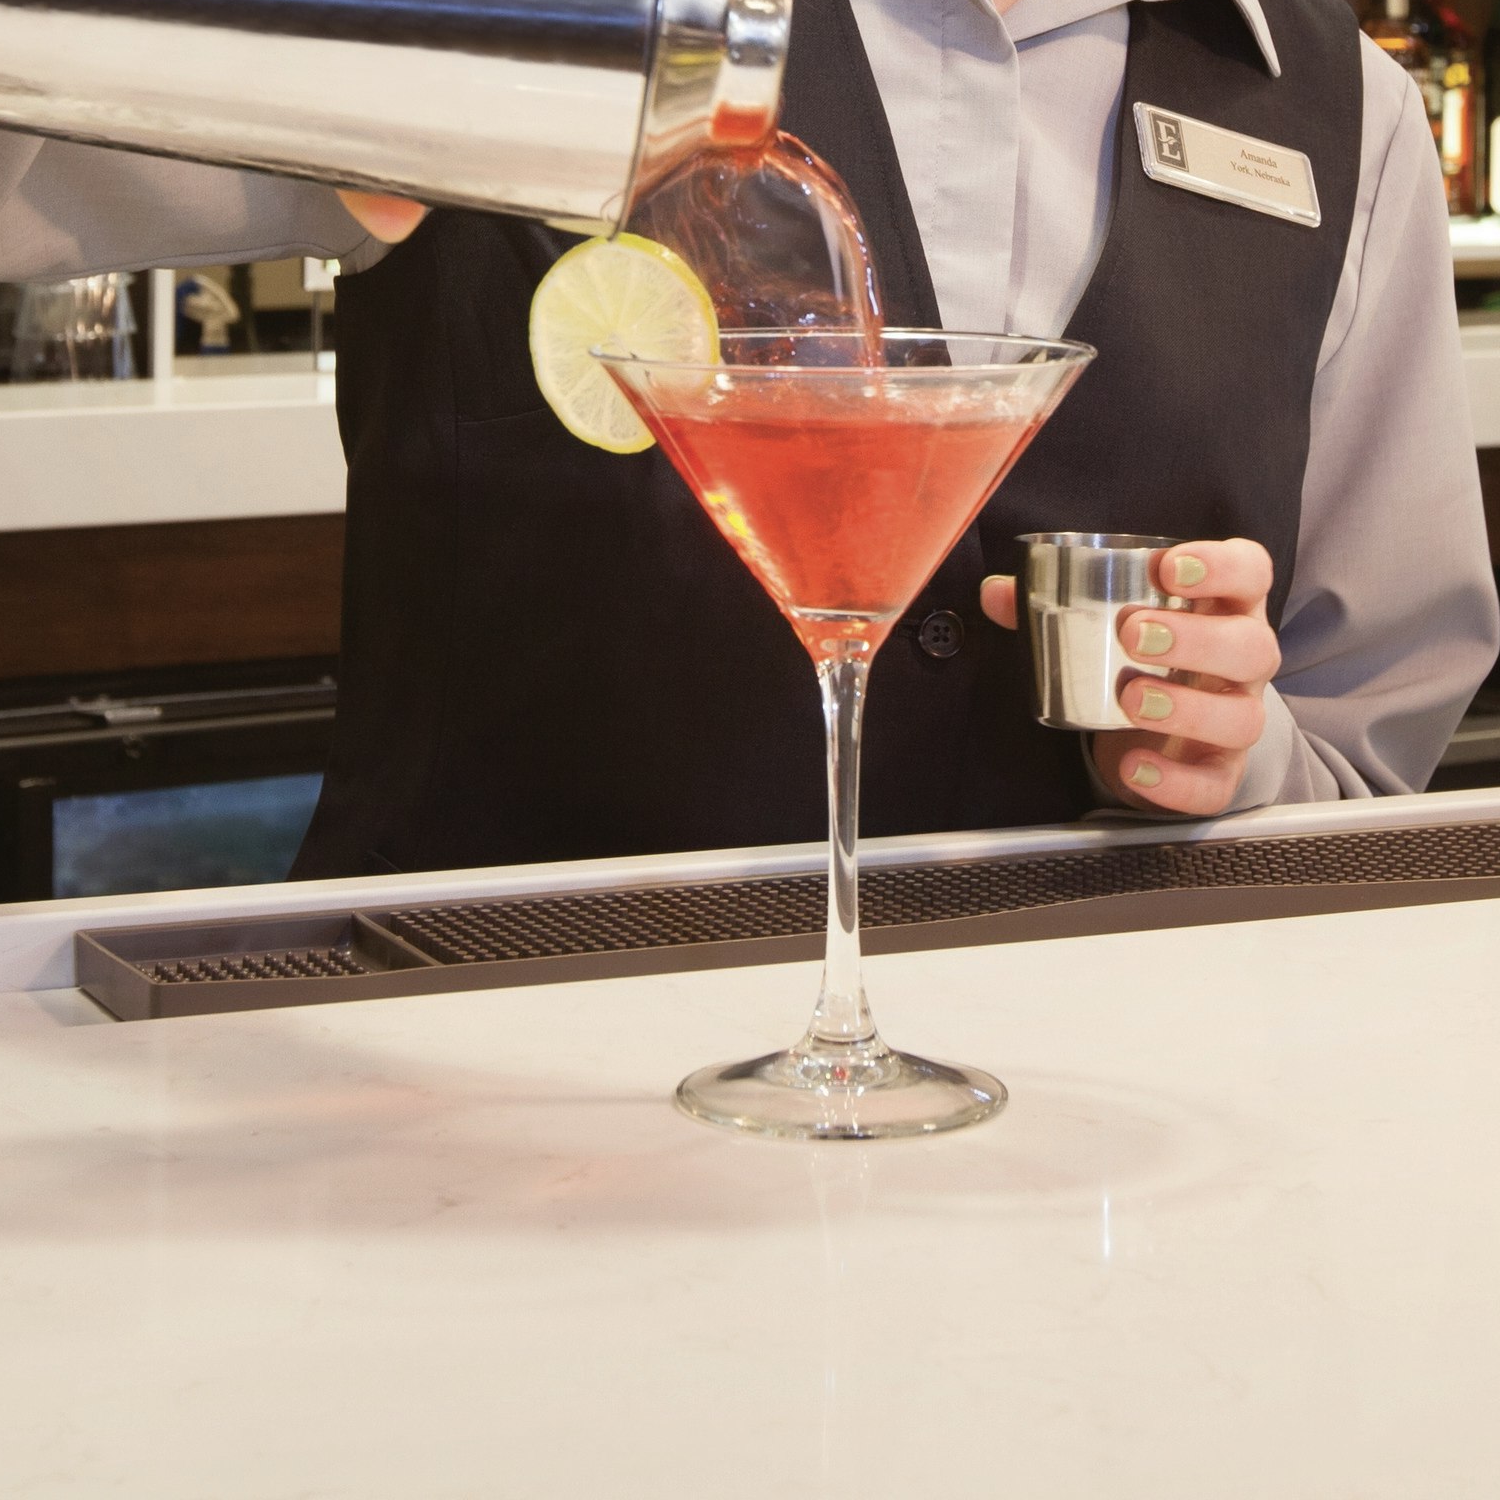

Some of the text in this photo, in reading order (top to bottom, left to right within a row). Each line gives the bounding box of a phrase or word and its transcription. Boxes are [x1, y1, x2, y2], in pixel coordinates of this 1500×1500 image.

[1240, 149, 1278, 169] Amanda
[1230, 160, 1291, 187] York, Nebraska
